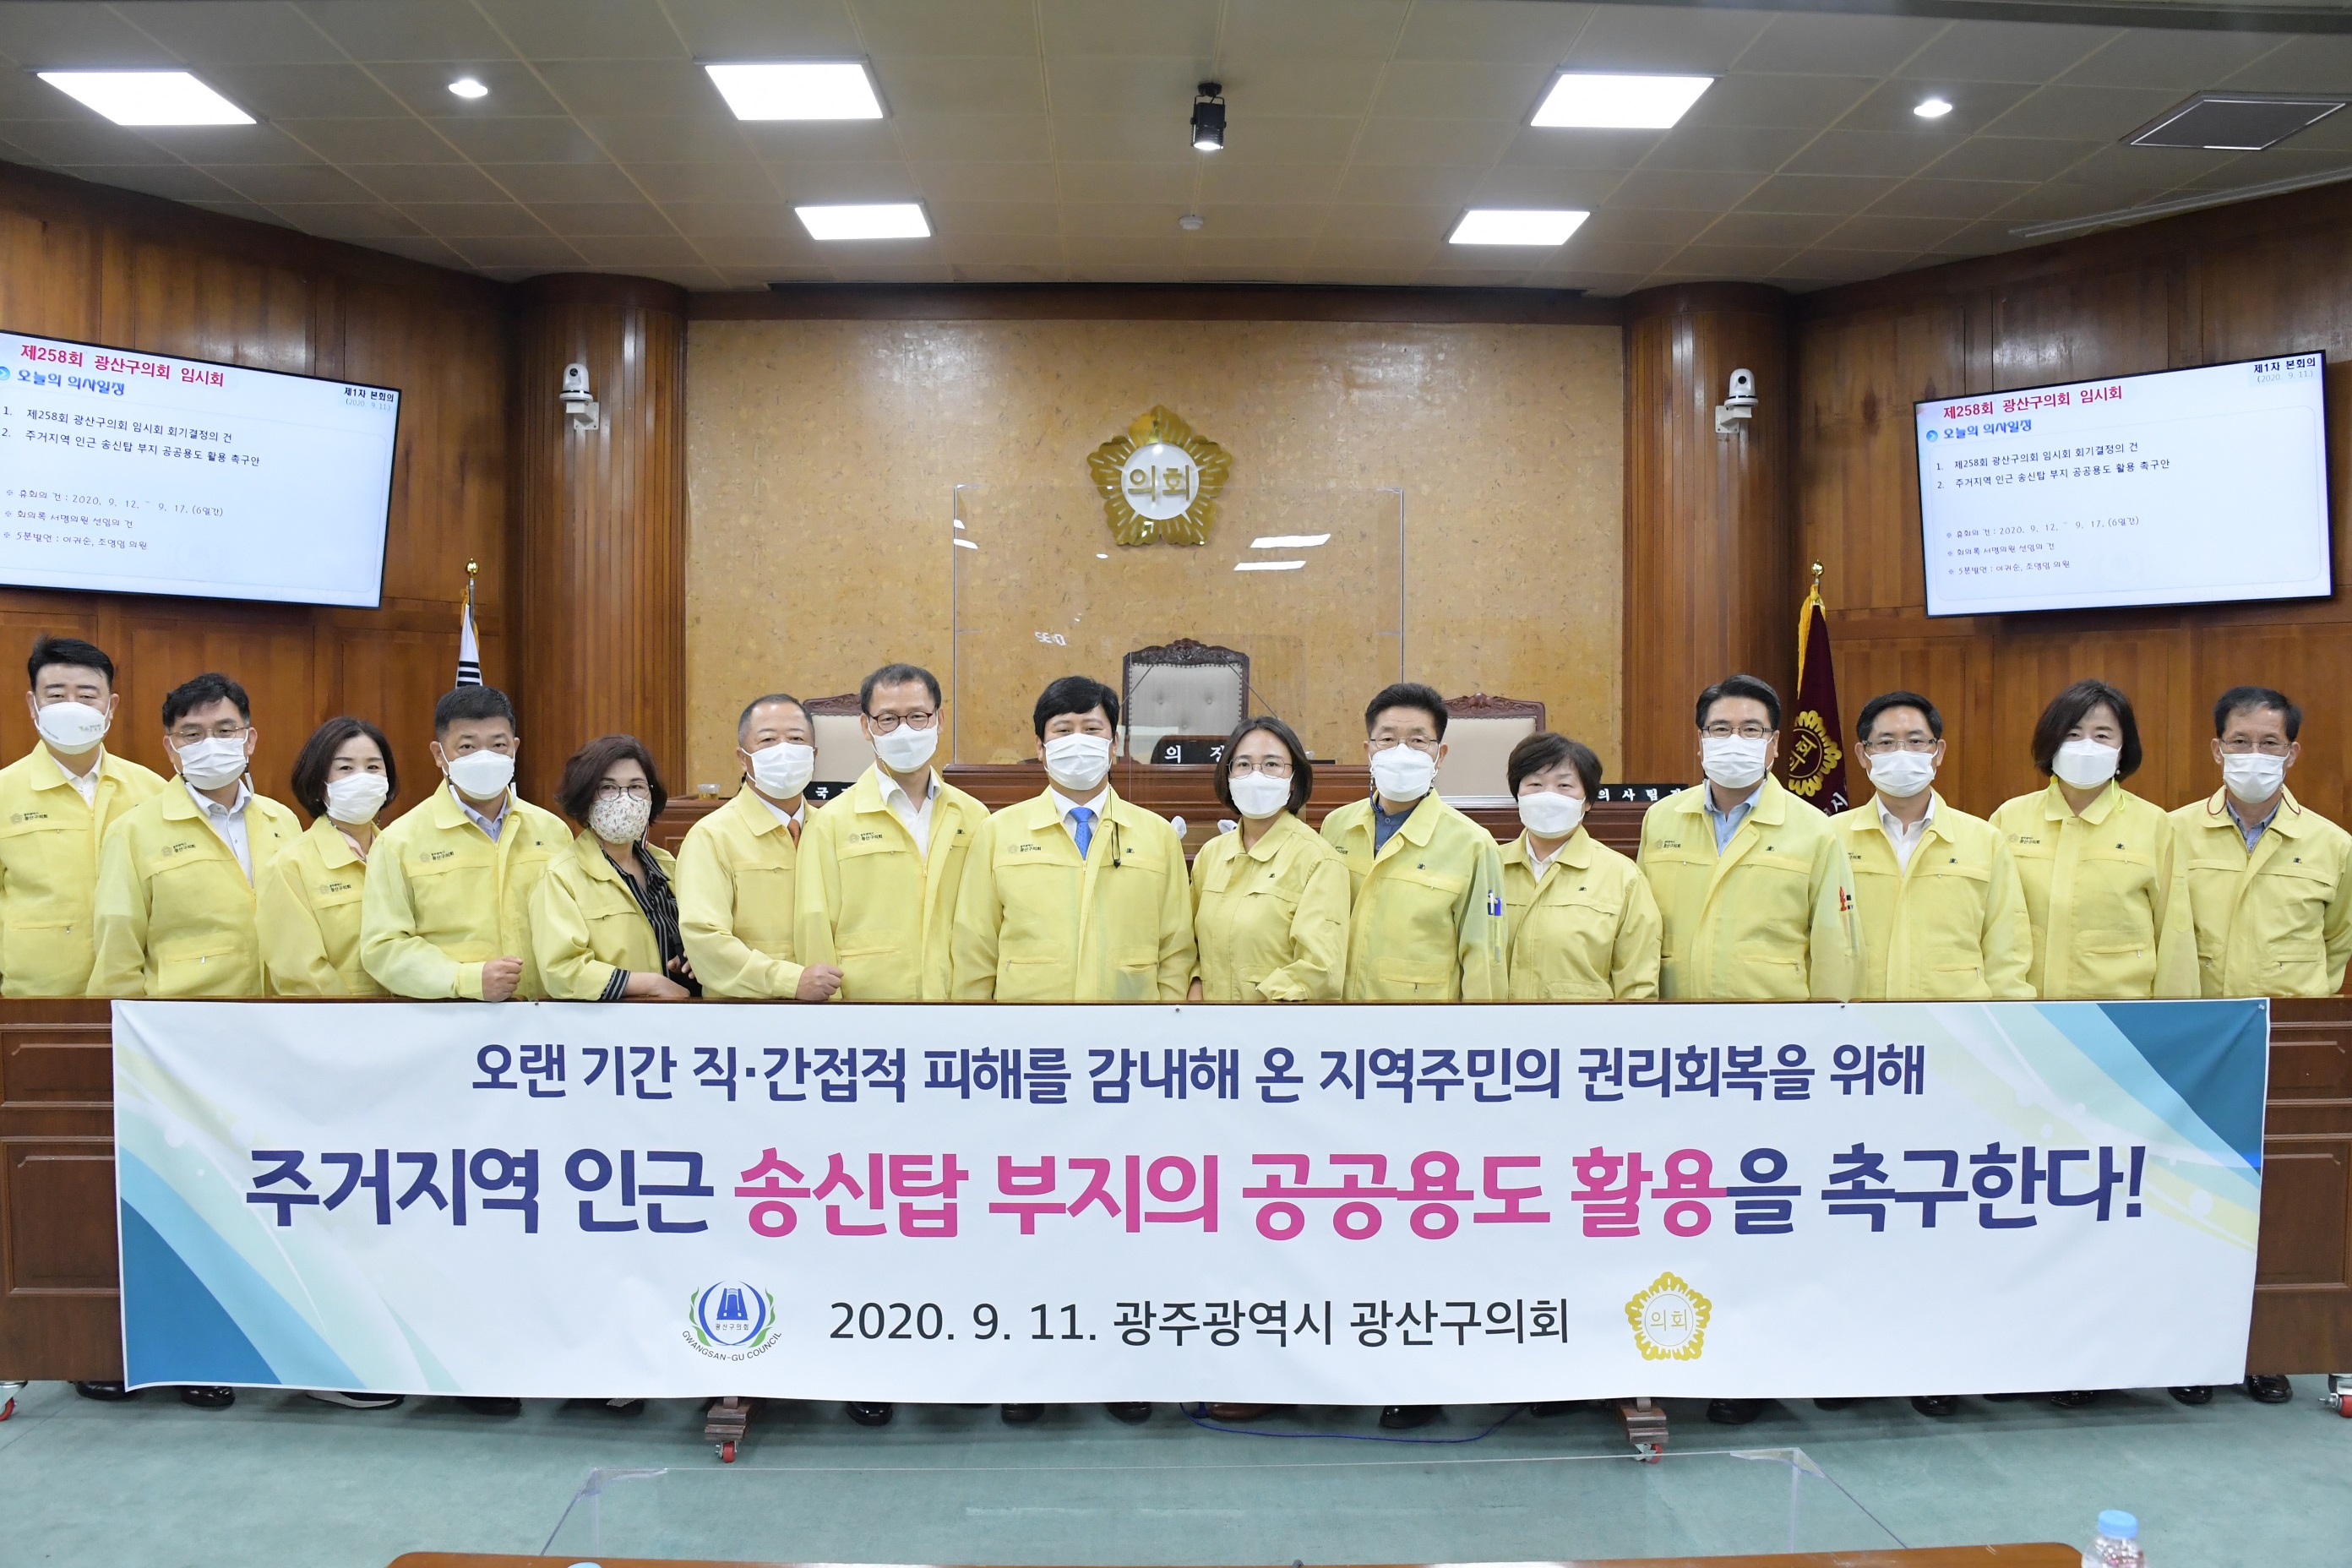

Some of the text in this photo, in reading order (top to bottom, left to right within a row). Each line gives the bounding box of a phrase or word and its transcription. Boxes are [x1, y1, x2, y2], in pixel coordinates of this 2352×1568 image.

[21, 344, 224, 387] 제258회 광산구의회 임시회
[2285, 357, 2316, 369] 본회의
[17, 369, 125, 395] 오늘의 의사일정
[1943, 385, 2122, 420] 제258회 광산구의회 임시회
[3, 406, 232, 444] 1. 제258회 광산구의회 임시회 회기결정의 건
[1943, 418, 2032, 439] 오늘의 의사일정
[2, 427, 259, 466] 2. 주거지역 인근 송신탑 부지 공공용도 활용 촉구안
[1936, 442, 2138, 471] 1. 제258회 광산구의회 임시회 회기결정의 건
[1127, 465, 1191, 502] 의회
[1936, 459, 2170, 489] 2. 주거지역 인근 송신탑 부지 공공용도 활용 촉구안
[473, 1044, 565, 1097] 오랜
[583, 1047, 677, 1099] 기간
[925, 1047, 1070, 1103] 피해를
[1089, 1047, 1238, 1102] 감내해
[1256, 1048, 1303, 1102] 온
[1320, 1048, 1560, 1102] 지역주민의
[1579, 1044, 1815, 1101] 권리회복을
[1831, 1043, 1924, 1095] 위해
[247, 1141, 2145, 1240] 주거지역 인근 송신탑 부지의 공공용도 활용을 촉구한다!
[830, 1299, 1567, 1347] 2020. 9. 11. 광주광역시 광산구의회
[1650, 1309, 1688, 1331] 의회
[682, 1331, 781, 1362] GWANGSAN-GU COUNCIL
